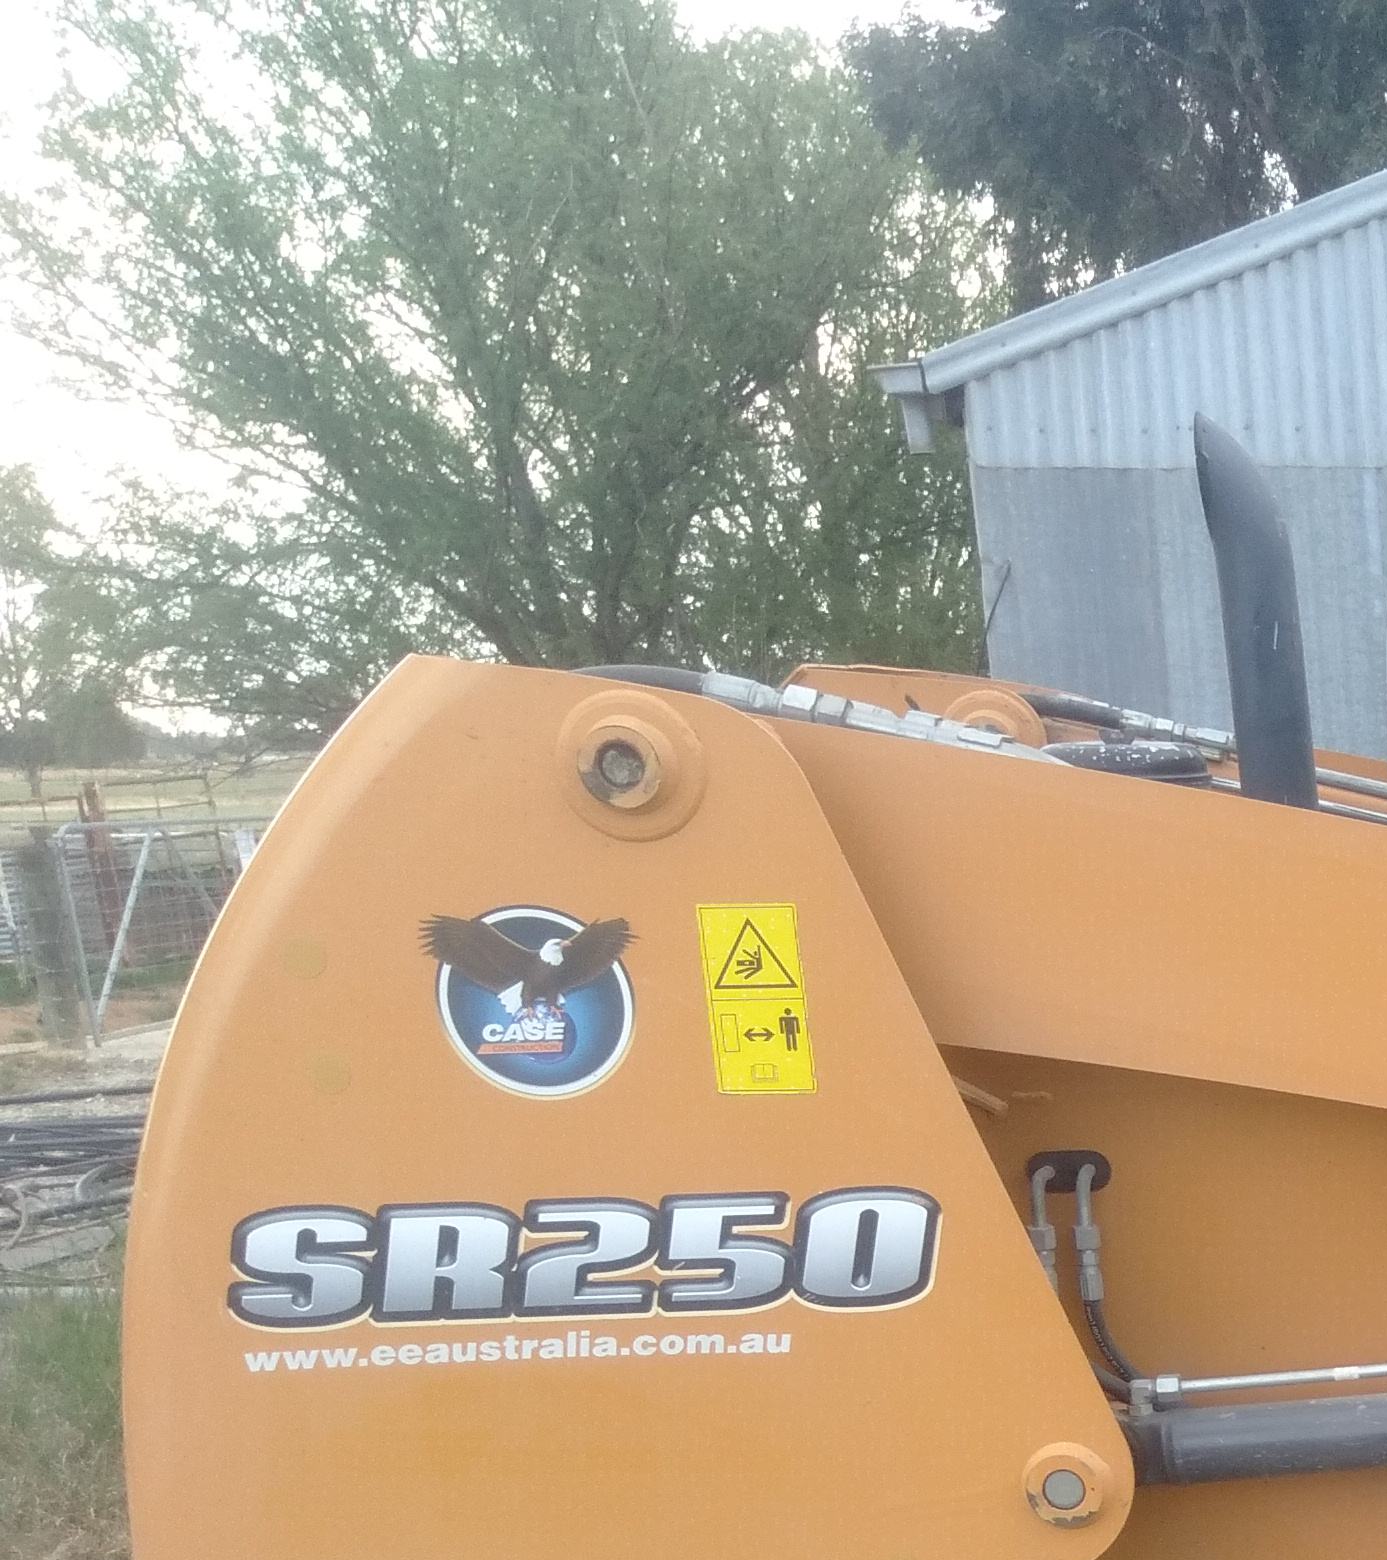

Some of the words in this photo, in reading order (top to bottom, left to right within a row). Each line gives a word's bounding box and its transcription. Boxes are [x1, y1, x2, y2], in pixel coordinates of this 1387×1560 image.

[482, 1021, 565, 1042] CASE
[230, 1186, 940, 1330] SR250
[244, 1330, 792, 1373] www.eeaustralia.com.au
